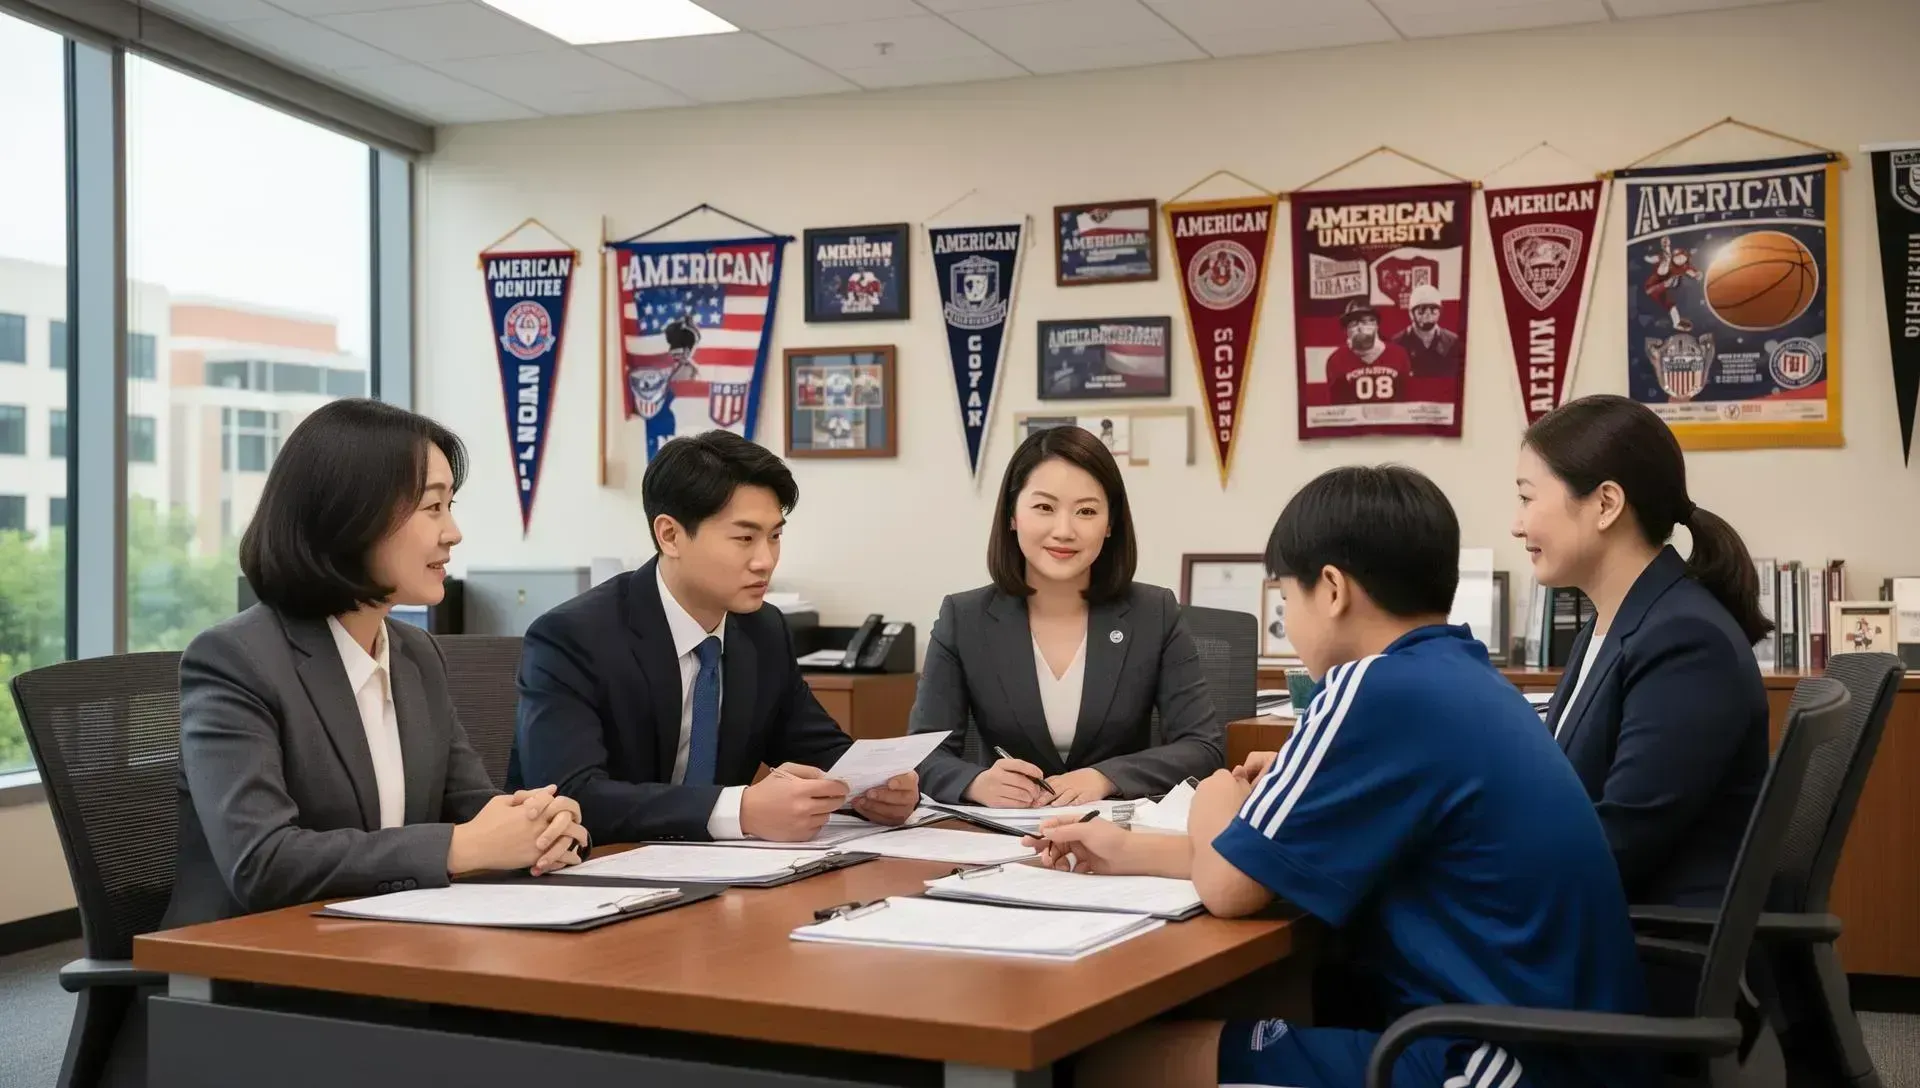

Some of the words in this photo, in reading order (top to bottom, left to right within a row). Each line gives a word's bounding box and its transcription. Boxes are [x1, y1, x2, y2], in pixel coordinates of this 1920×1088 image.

[1490, 188, 1595, 218] AMERICAN
[1633, 175, 1814, 236] AMERICAN
[1176, 211, 1268, 238] AMERICAN
[1306, 201, 1455, 231] AMERICAN
[935, 231, 1017, 254] AMERICAN
[1318, 223, 1444, 247] UNIVERSITY
[817, 242, 893, 261] AMERICAN
[488, 258, 570, 280] AMERICAN
[627, 250, 772, 289] AMERICAN
[1356, 375, 1394, 399] 08
